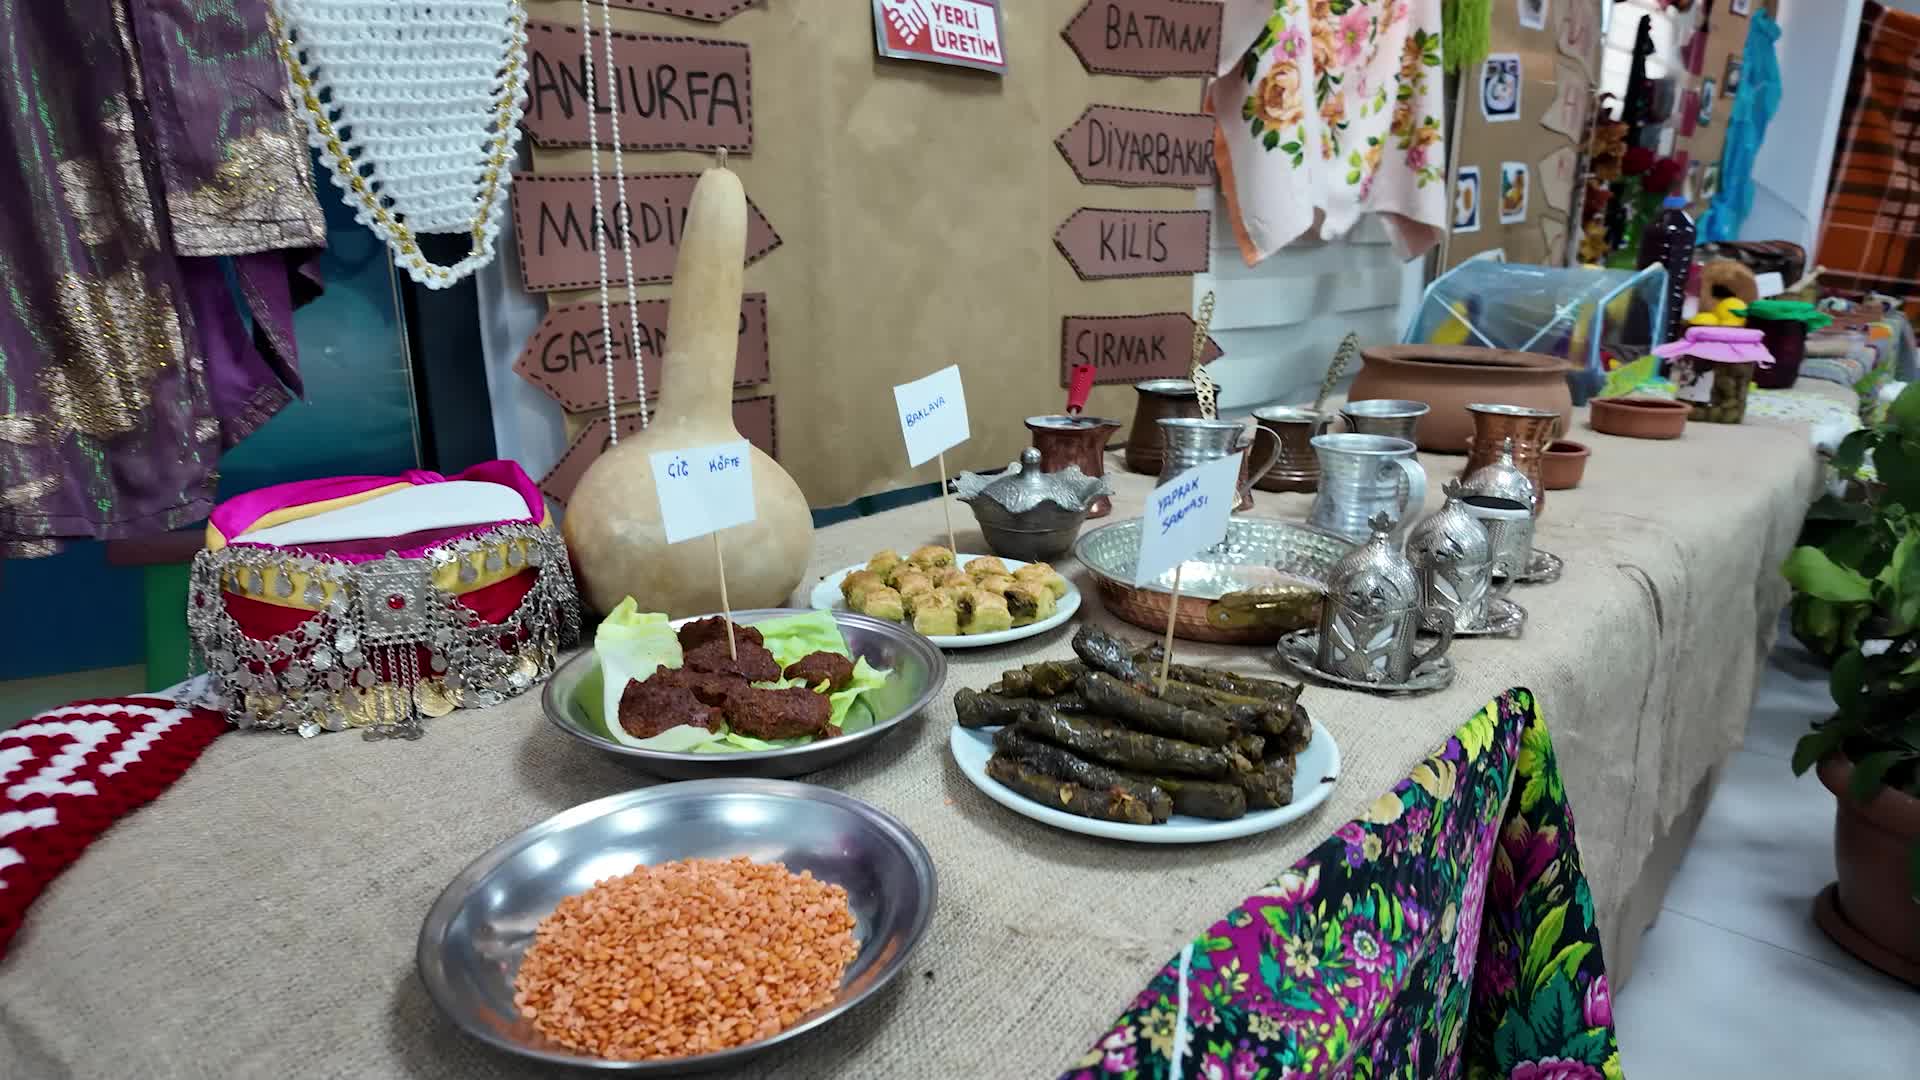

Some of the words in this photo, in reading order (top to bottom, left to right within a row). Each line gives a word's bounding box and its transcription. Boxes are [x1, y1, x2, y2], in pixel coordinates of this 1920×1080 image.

[931, 1, 980, 30] YERLİ
[1105, 3, 1212, 54] BATMAN
[935, 24, 998, 58] ÜRETİM
[1087, 118, 1216, 177] DİYARBAKIR
[1100, 217, 1169, 262] KİLİS
[905, 396, 946, 428] BAKLAVA
[709, 454, 741, 473] KÖFTE
[1157, 476, 1200, 515] YAPRAK
